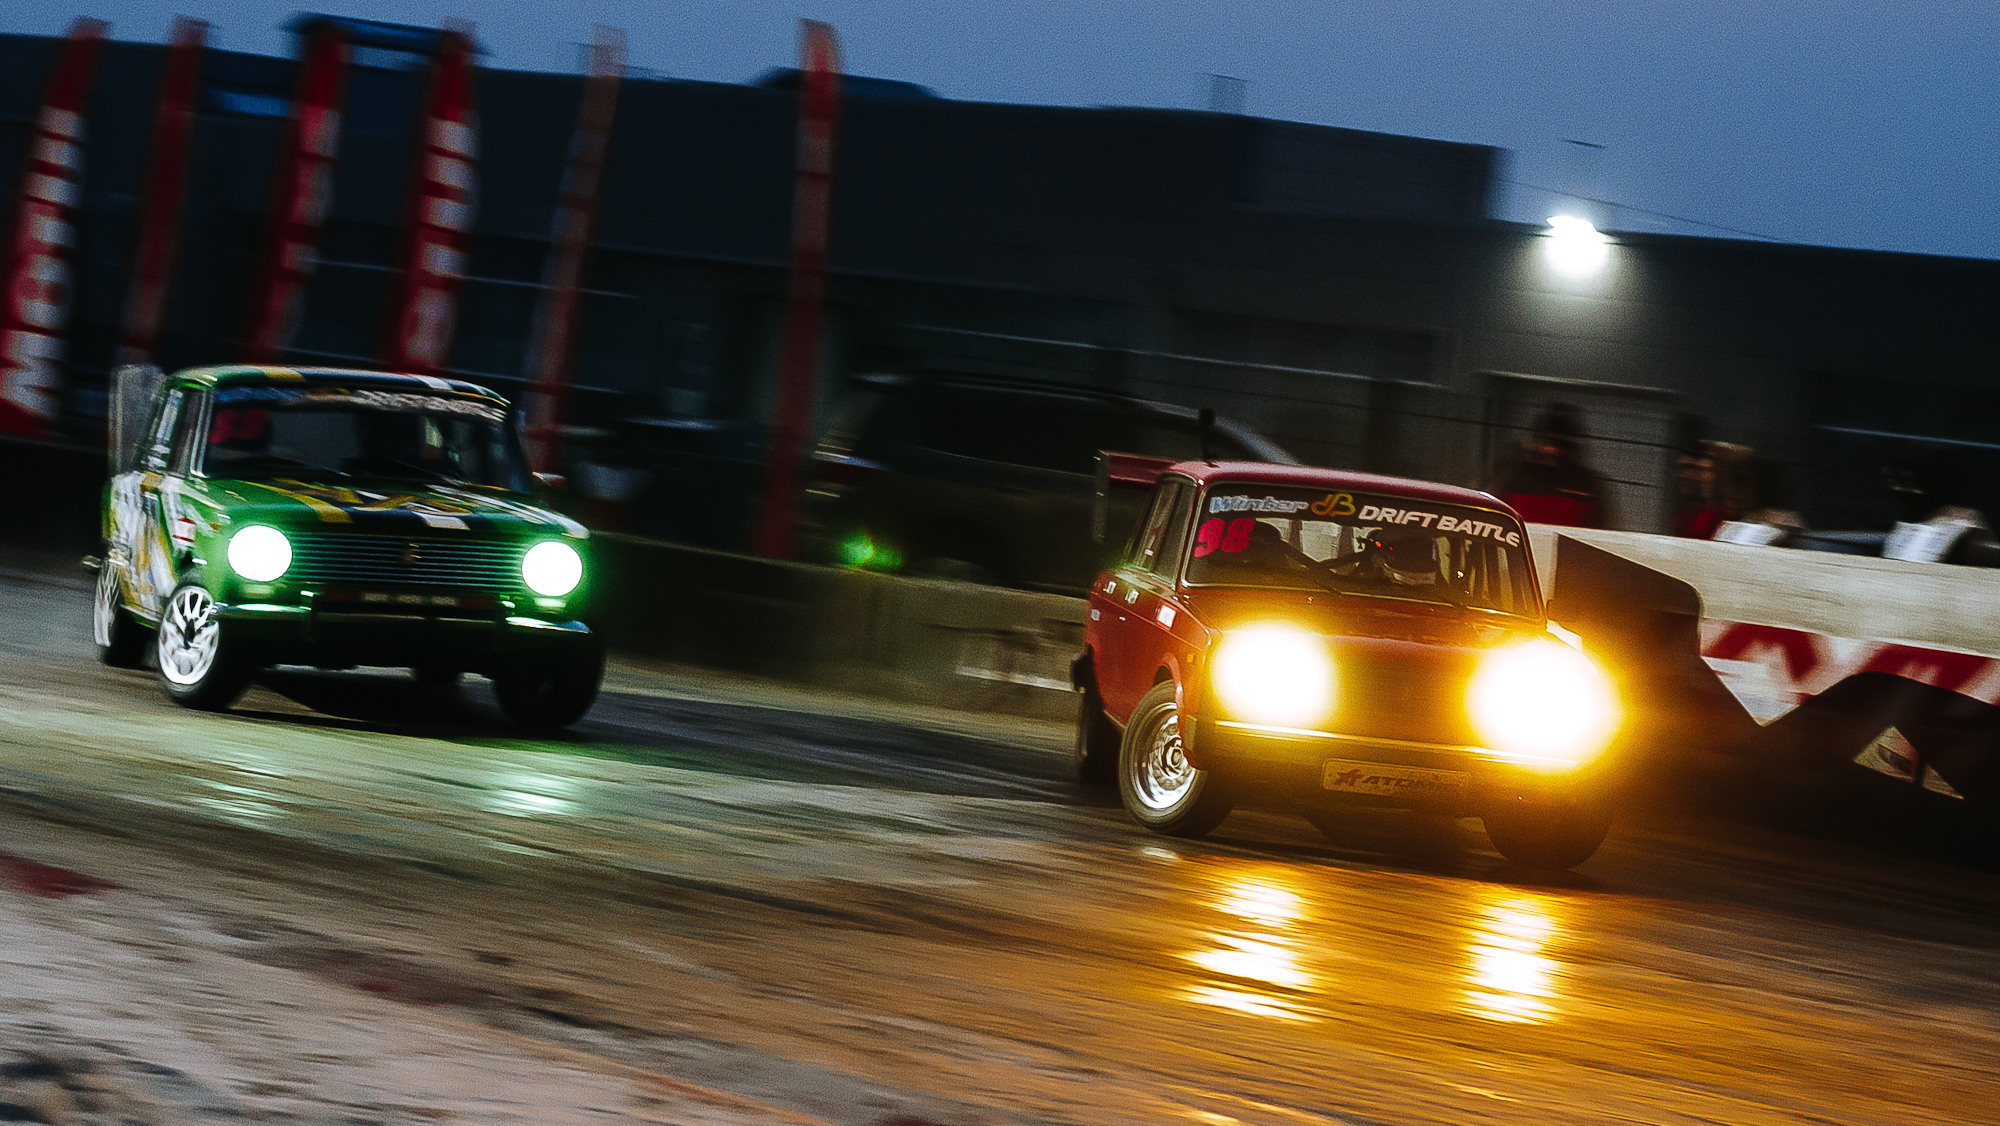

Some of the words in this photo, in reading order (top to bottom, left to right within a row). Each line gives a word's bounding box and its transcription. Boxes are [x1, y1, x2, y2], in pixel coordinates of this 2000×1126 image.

[1194, 518, 1254, 558] 98
[1210, 495, 1309, 513] Winter
[1358, 505, 1439, 528] DRIFT
[1436, 516, 1520, 547] BATTLE
